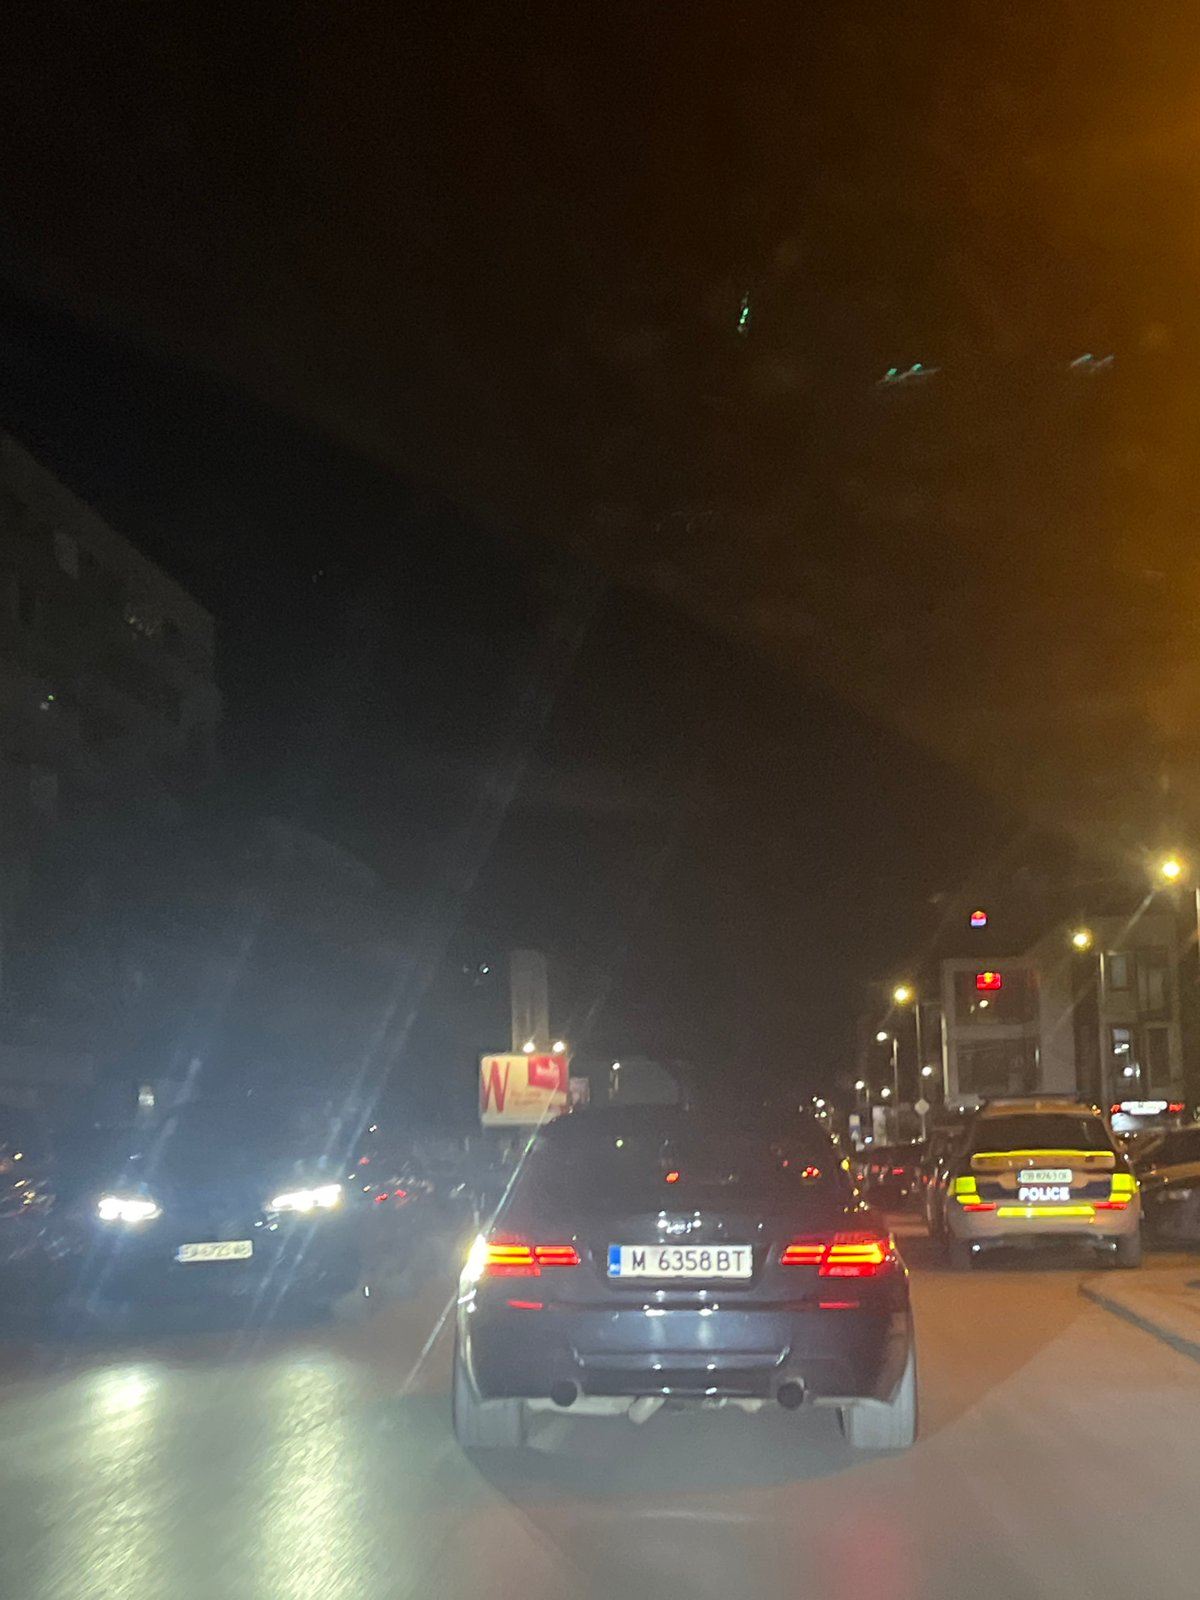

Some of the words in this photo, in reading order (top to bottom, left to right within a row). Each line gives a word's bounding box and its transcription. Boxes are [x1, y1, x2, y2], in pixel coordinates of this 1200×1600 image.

[1019, 1187, 1070, 1201] POLICE
[632, 1250, 646, 1271] M
[658, 1250, 711, 1271] 6358
[717, 1250, 745, 1271] BT
